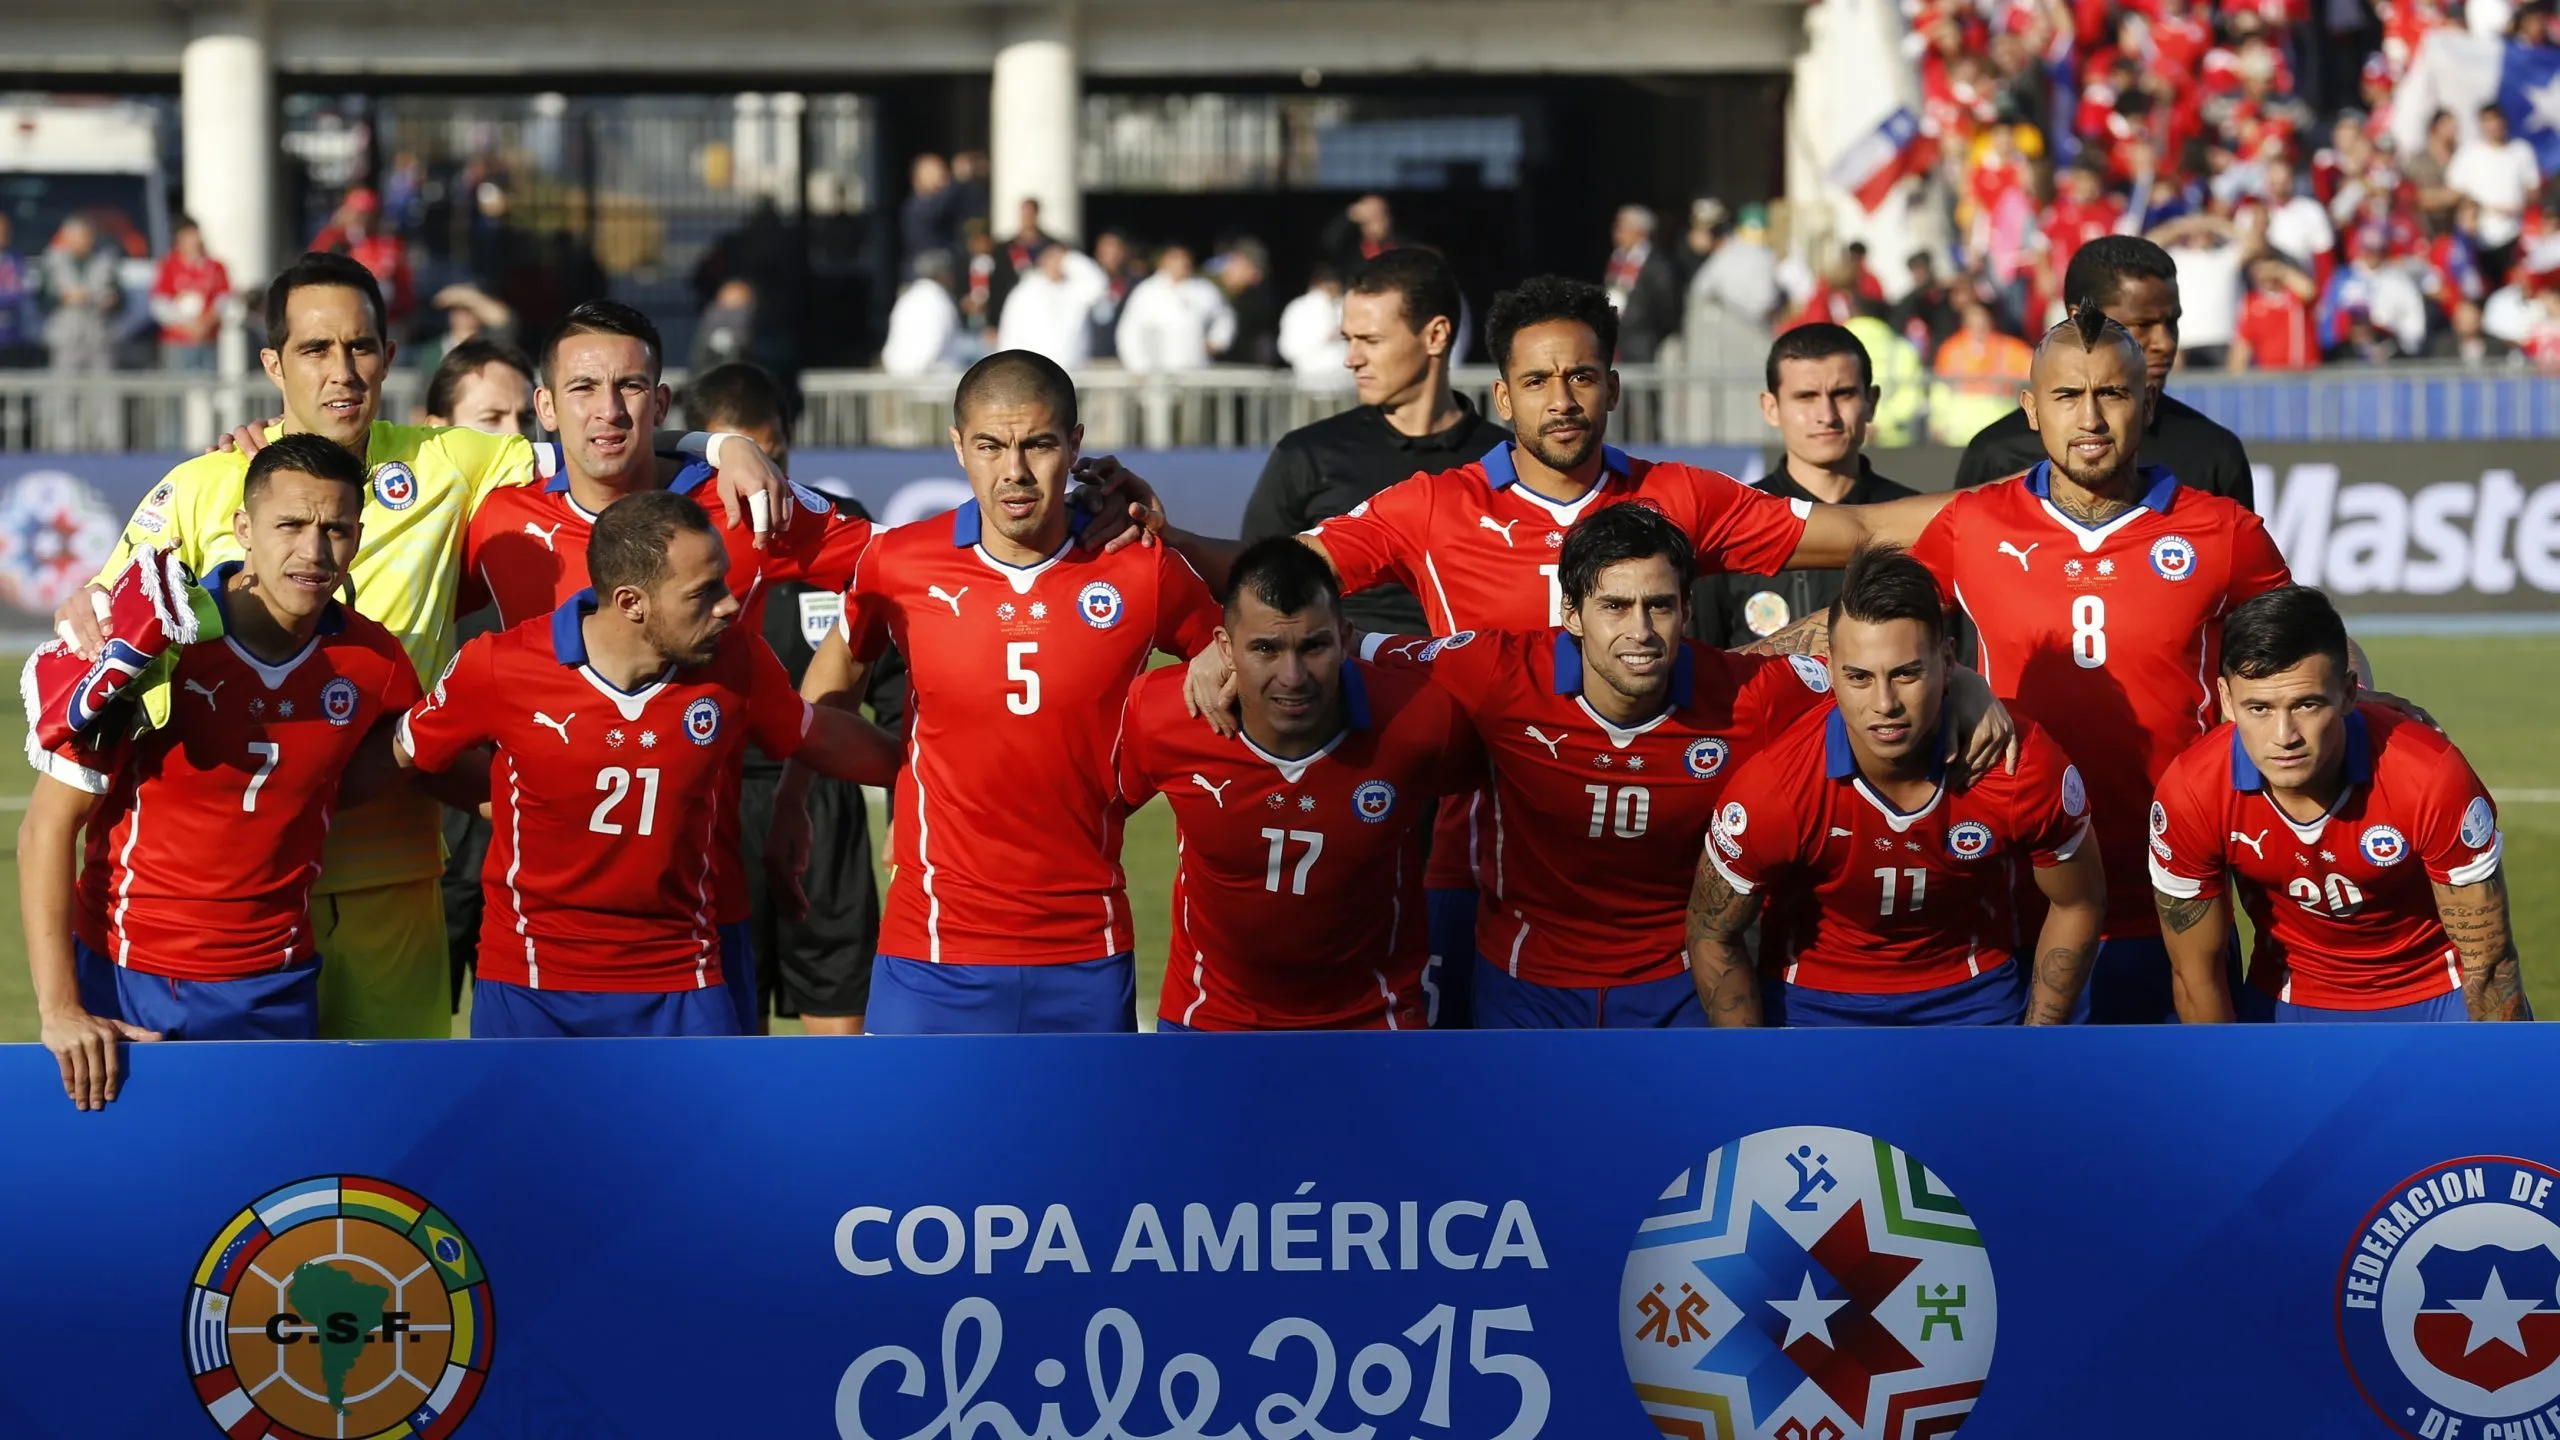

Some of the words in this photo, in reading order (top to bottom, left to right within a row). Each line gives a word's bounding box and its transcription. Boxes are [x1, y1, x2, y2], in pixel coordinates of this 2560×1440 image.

[2071, 594, 2107, 669] 8
[1006, 641, 1040, 716] 5
[243, 742, 280, 812] 7
[588, 766, 660, 836] 21
[1584, 785, 1650, 839] 10
[1261, 827, 1325, 897] 17
[1873, 867, 1927, 916] 11
[2287, 872, 2364, 919] 20
[834, 1203, 1091, 1276] COPA
[1110, 1181, 1549, 1273] AMÉRICA
[2346, 1167, 2486, 1309] FEDERACION
[2509, 1169, 2553, 1209] DE
[265, 1311, 421, 1345] C.S.F.
[1249, 1303, 1551, 1440] 2015
